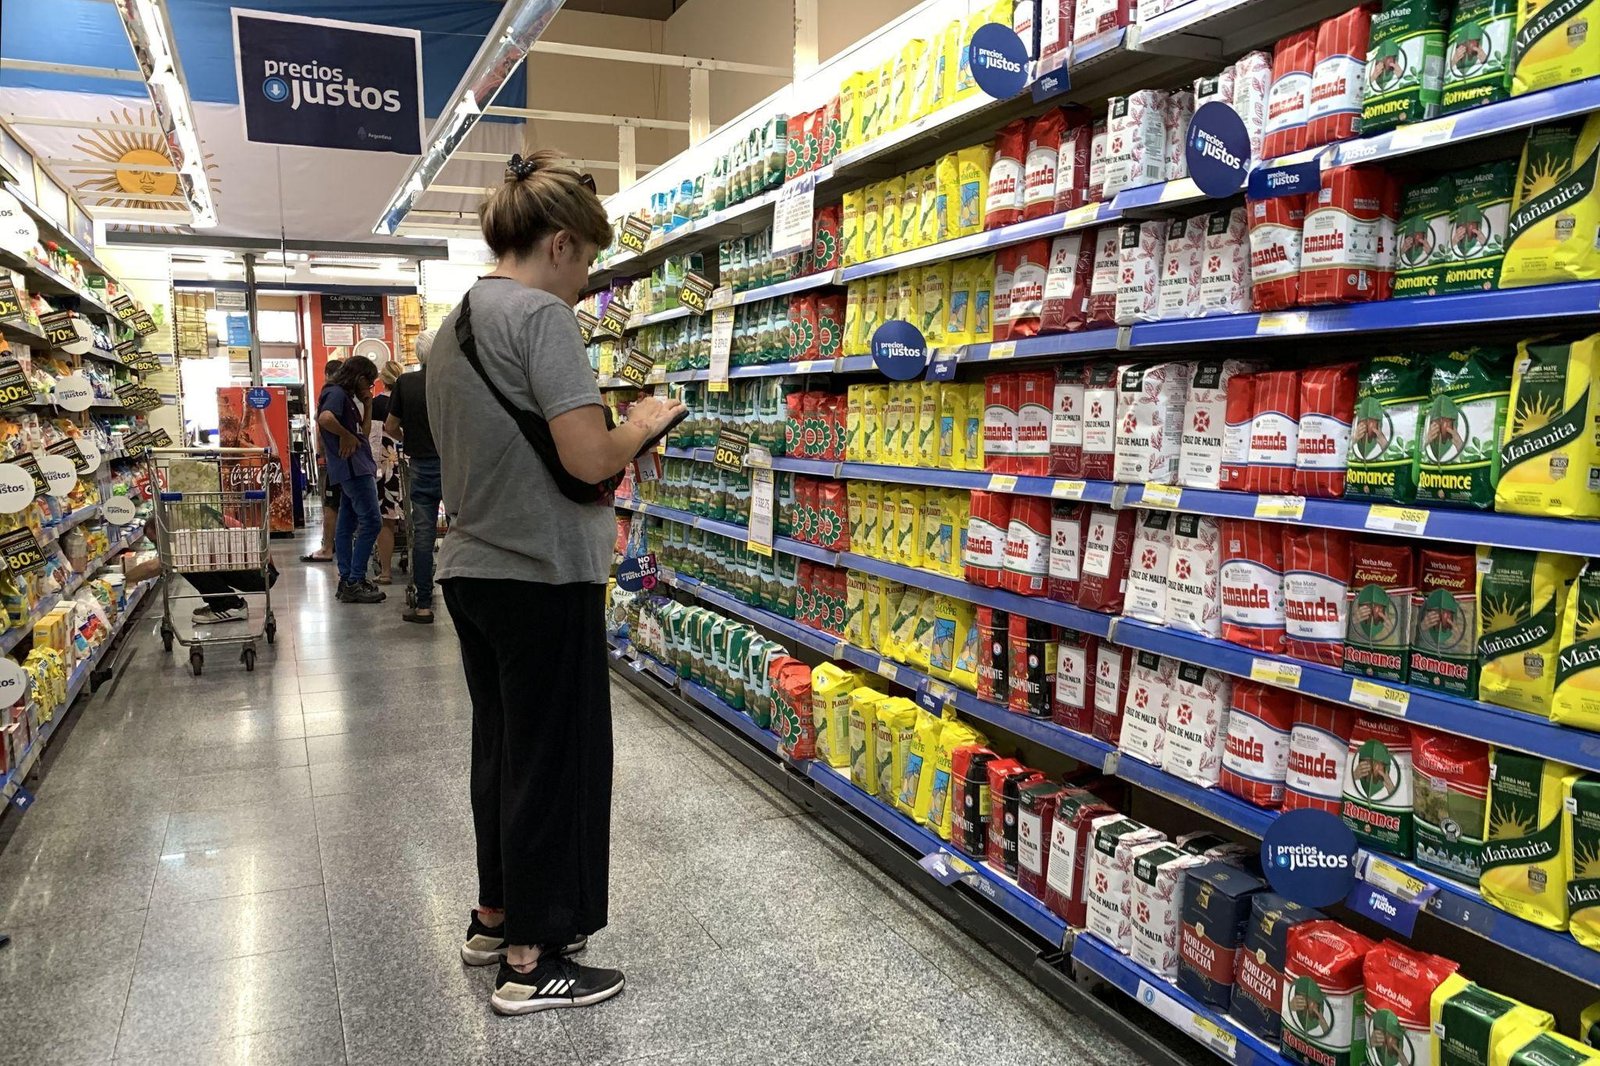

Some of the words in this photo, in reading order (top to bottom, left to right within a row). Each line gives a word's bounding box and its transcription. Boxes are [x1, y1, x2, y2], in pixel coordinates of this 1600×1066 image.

[1391, 7, 1411, 19] Mate
[979, 47, 1003, 58] precios
[264, 60, 343, 81] precios
[985, 56, 1021, 73] justos
[291, 78, 401, 112] justos
[1311, 76, 1346, 104] amanda
[1443, 85, 1494, 106] Romance
[1363, 99, 1410, 119] Romance
[1198, 129, 1224, 148] precios
[1202, 140, 1241, 169] justos
[1344, 145, 1377, 161] justos
[1267, 171, 1287, 180] precios
[1272, 174, 1300, 188] justos
[1474, 172, 1494, 182] Mate
[1509, 182, 1585, 237] Mañanita
[621, 232, 643, 250] 80%
[1304, 229, 1344, 253] amanda
[1173, 277, 1188, 285] MALTA
[1216, 274, 1231, 282] MALTA
[1395, 275, 1438, 290] Romance
[1445, 267, 1494, 283] Romance
[1012, 282, 1042, 302] amanda
[1130, 285, 1143, 293] MALTA
[681, 288, 705, 309] 80%
[602, 317, 621, 333] 70%
[48, 329, 74, 343] 70%
[888, 346, 921, 358] justos
[623, 364, 644, 382] 80%
[1067, 414, 1080, 422] MALTA
[1124, 437, 1130, 445] DE
[1131, 437, 1149, 447] MALTA
[1183, 435, 1193, 445] CRUZ
[1194, 436, 1201, 445] DE
[1202, 437, 1221, 447] MALTA
[1252, 432, 1287, 450] amanda
[1501, 421, 1577, 468] Mañanita
[716, 448, 740, 465] 80%
[47, 472, 71, 481] ustos
[1346, 468, 1395, 486] Romance
[1419, 471, 1472, 490] Romance
[9, 551, 40, 570] 80%
[637, 556, 650, 564] NO
[1062, 548, 1075, 557] MALTA
[640, 567, 656, 577] DAD
[1361, 558, 1377, 566] Yerba
[1377, 560, 1392, 568] Mate
[1131, 569, 1141, 579] CRUZ
[1141, 571, 1148, 581] DE
[1149, 574, 1168, 585] MALTA
[1355, 570, 1398, 584] Especial
[1424, 573, 1466, 589] Especial
[1177, 581, 1184, 591] DE
[1185, 584, 1203, 596] MALTA
[1223, 584, 1269, 608] amanda
[1285, 597, 1339, 622] amanda
[1479, 625, 1548, 658] Mañanita
[1344, 647, 1401, 669] Romance
[1411, 653, 1468, 680] Romance
[1069, 675, 1081, 685] MALTA
[1135, 711, 1140, 719] DE
[1141, 713, 1157, 726] MALTA
[1379, 721, 1399, 733] Mate
[1177, 726, 1183, 736] DE
[1184, 729, 1202, 744] MALTA
[1500, 775, 1515, 784] YERBA
[1517, 778, 1531, 788] MATE
[1343, 801, 1400, 831] Romance
[1277, 844, 1317, 855] precios
[1481, 839, 1552, 865] Mañanita
[1290, 851, 1348, 871] justos
[1096, 895, 1102, 906] DE
[1102, 898, 1119, 913] MALTA
[1371, 892, 1388, 902] precios
[1373, 898, 1397, 916] justos
[1139, 922, 1144, 933] DE
[1144, 928, 1162, 944] MALTA
[1183, 929, 1216, 961] NOBLEZA
[1183, 941, 1212, 972] GAUCHA
[1242, 954, 1277, 991] NOBLEZA
[1241, 969, 1272, 1002] GAUCHA
[1375, 982, 1396, 1000] Yerba
[1396, 994, 1412, 1007] Mate
[1282, 1028, 1336, 1066] Romance
